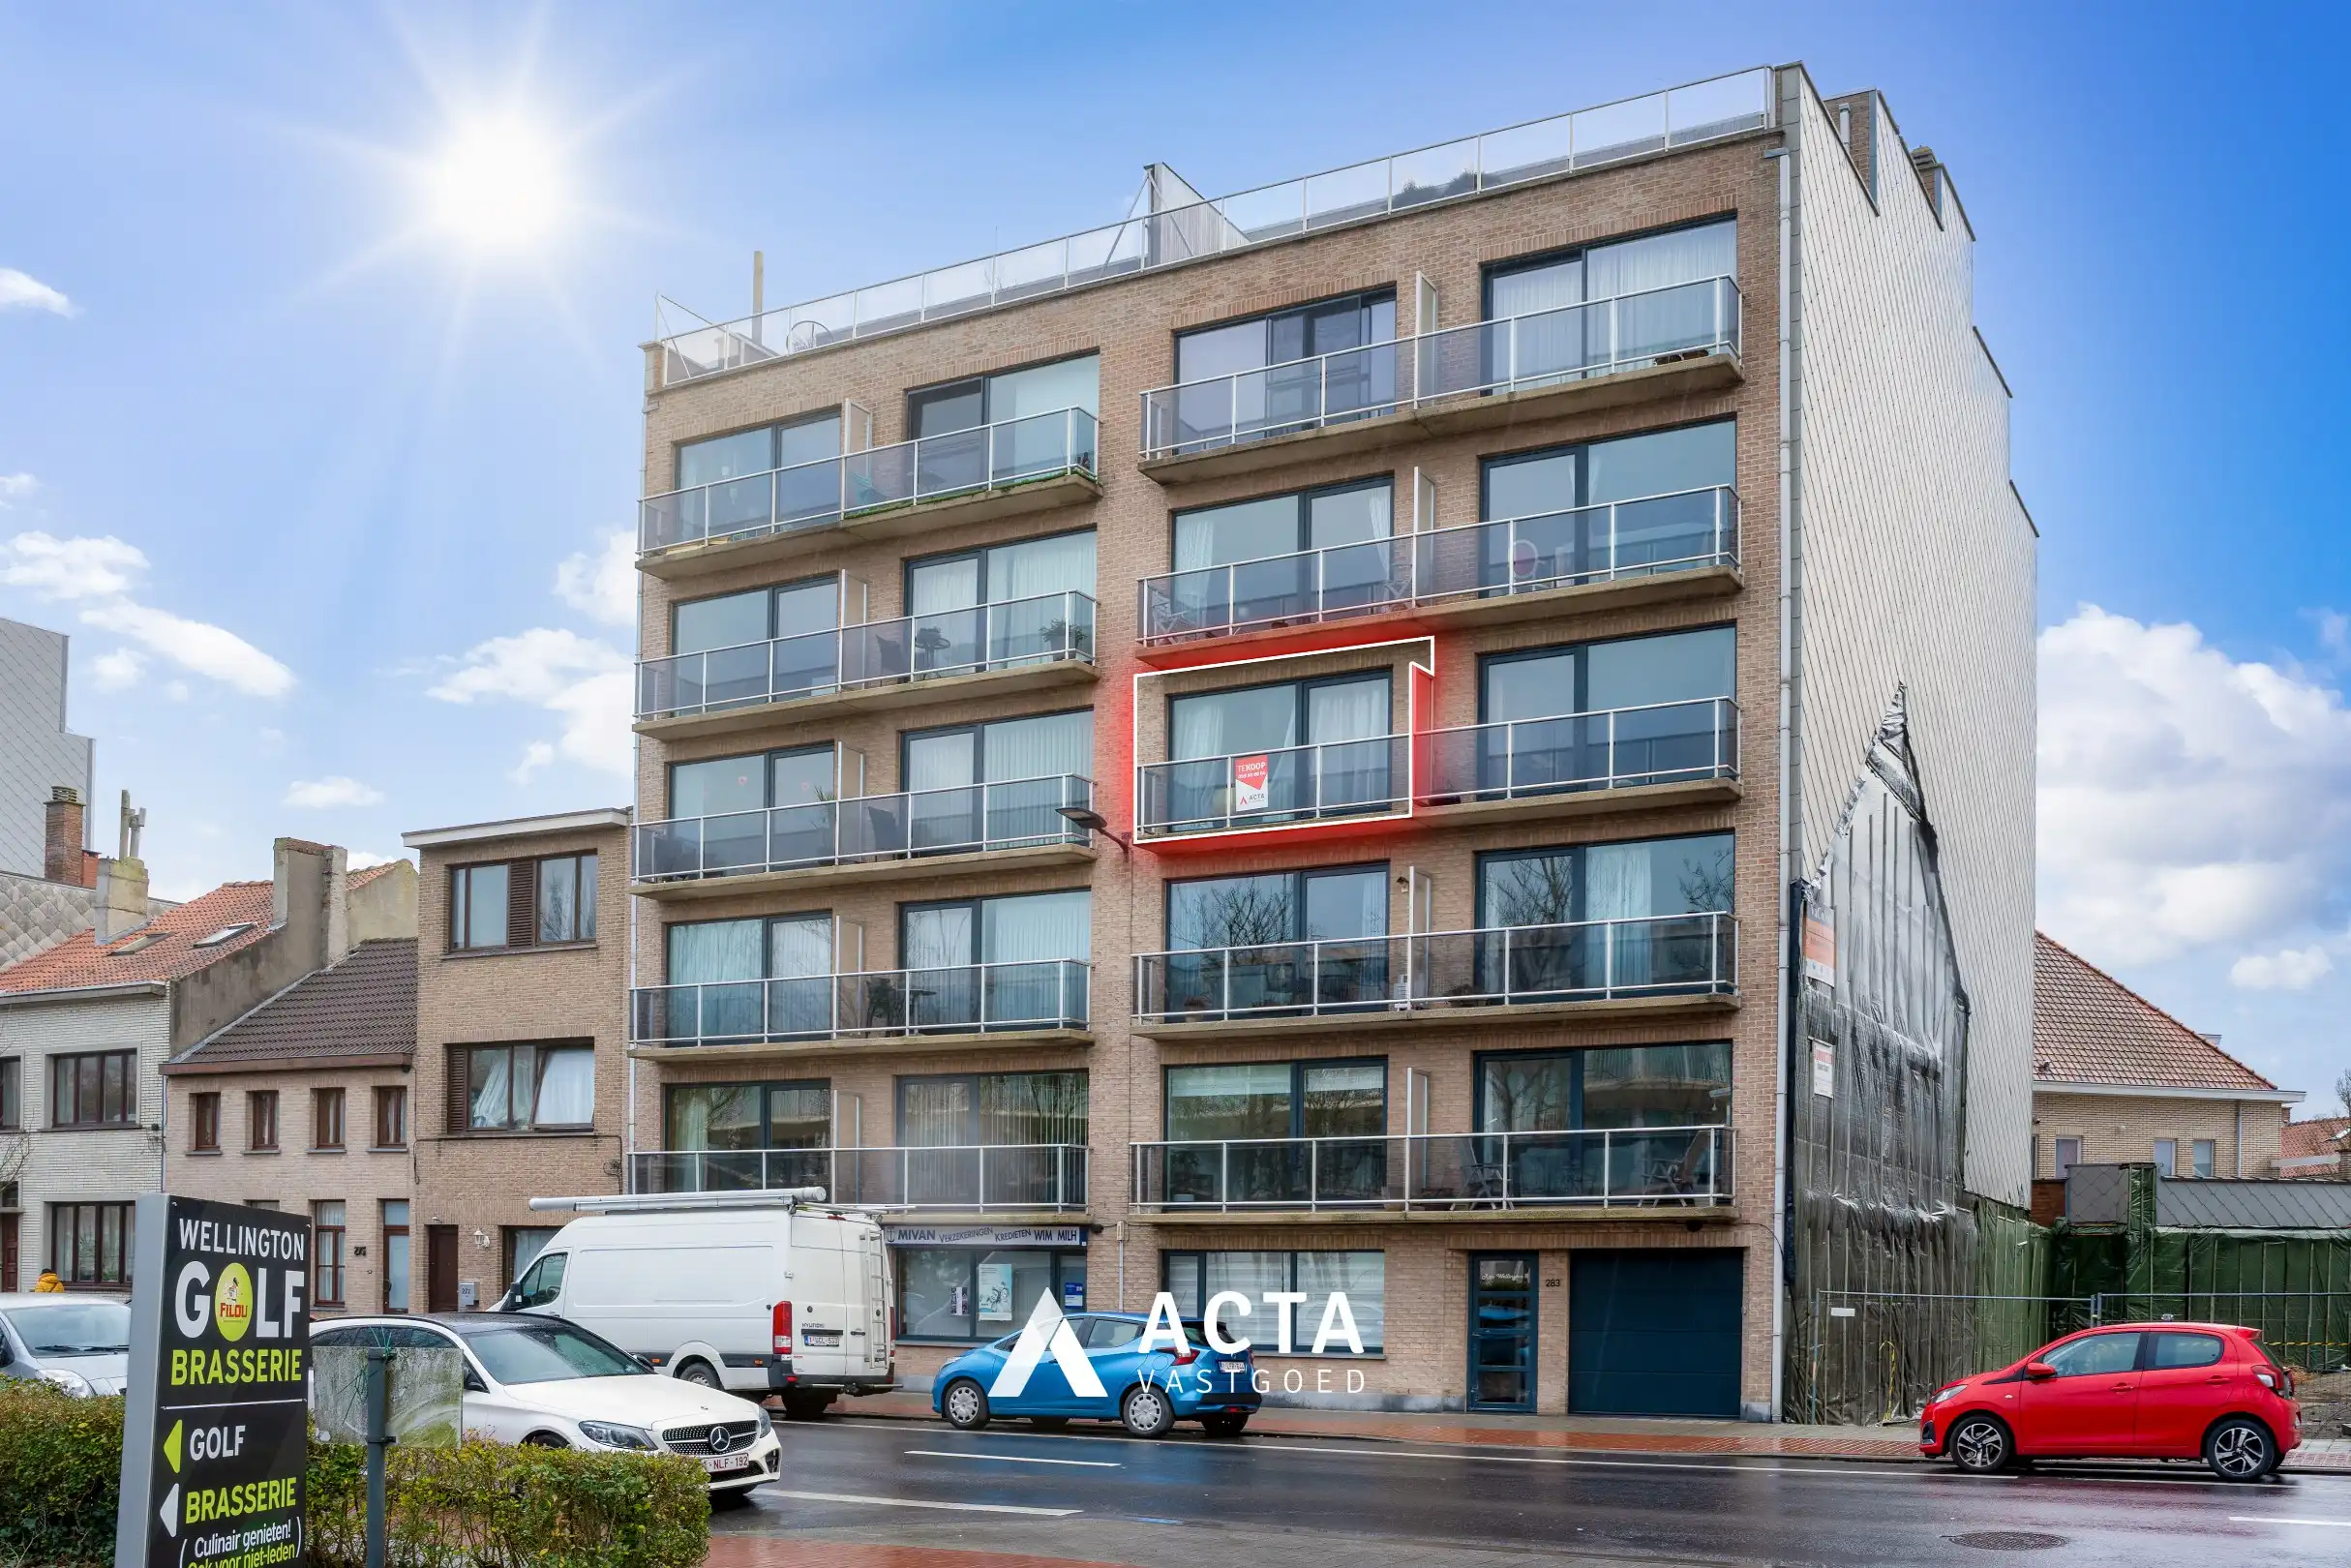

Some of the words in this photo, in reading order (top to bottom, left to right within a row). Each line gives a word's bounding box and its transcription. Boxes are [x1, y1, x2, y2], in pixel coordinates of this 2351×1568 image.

[179, 1218, 305, 1261] WELLINGTON
[898, 1229, 936, 1240] MIVAN
[939, 1227, 993, 1243] VERZEKERINGEN
[995, 1228, 1032, 1242] KREDIETEN
[1034, 1229, 1052, 1241] WIM
[1057, 1229, 1077, 1241] MILH
[174, 1260, 305, 1342] GOLF
[1546, 1279, 1561, 1287] 283
[220, 1302, 248, 1317] FILOU
[170, 1348, 302, 1385] BRASSERIE
[189, 1425, 246, 1461] GOLF
[185, 1477, 297, 1524] BRASSERIE
[195, 1529, 241, 1558] Culinair
[243, 1519, 291, 1553] genieten!
[243, 1542, 295, 1568] niet-leden
